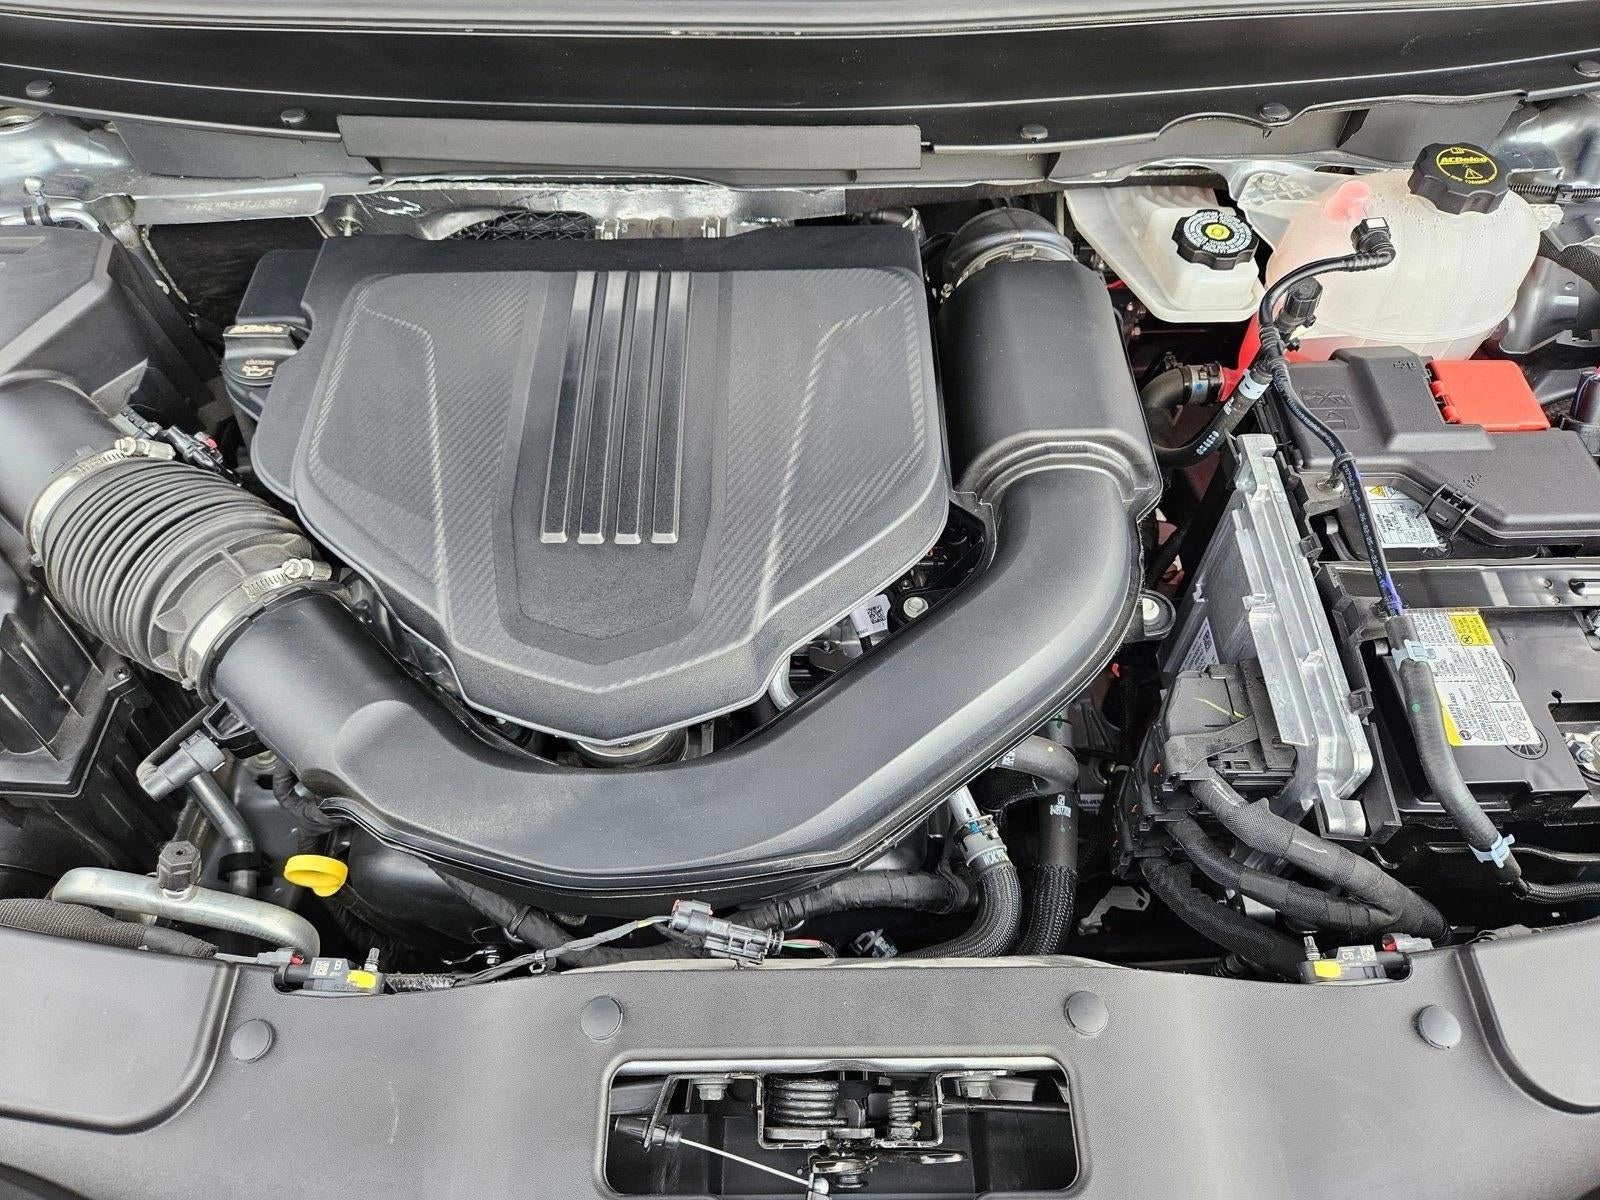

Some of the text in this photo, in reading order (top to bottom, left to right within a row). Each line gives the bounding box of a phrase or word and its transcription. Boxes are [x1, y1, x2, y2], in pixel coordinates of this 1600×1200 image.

[1440, 156, 1488, 165] ACDelco
[1342, 952, 1354, 960] CB
[334, 960, 342, 970] B
